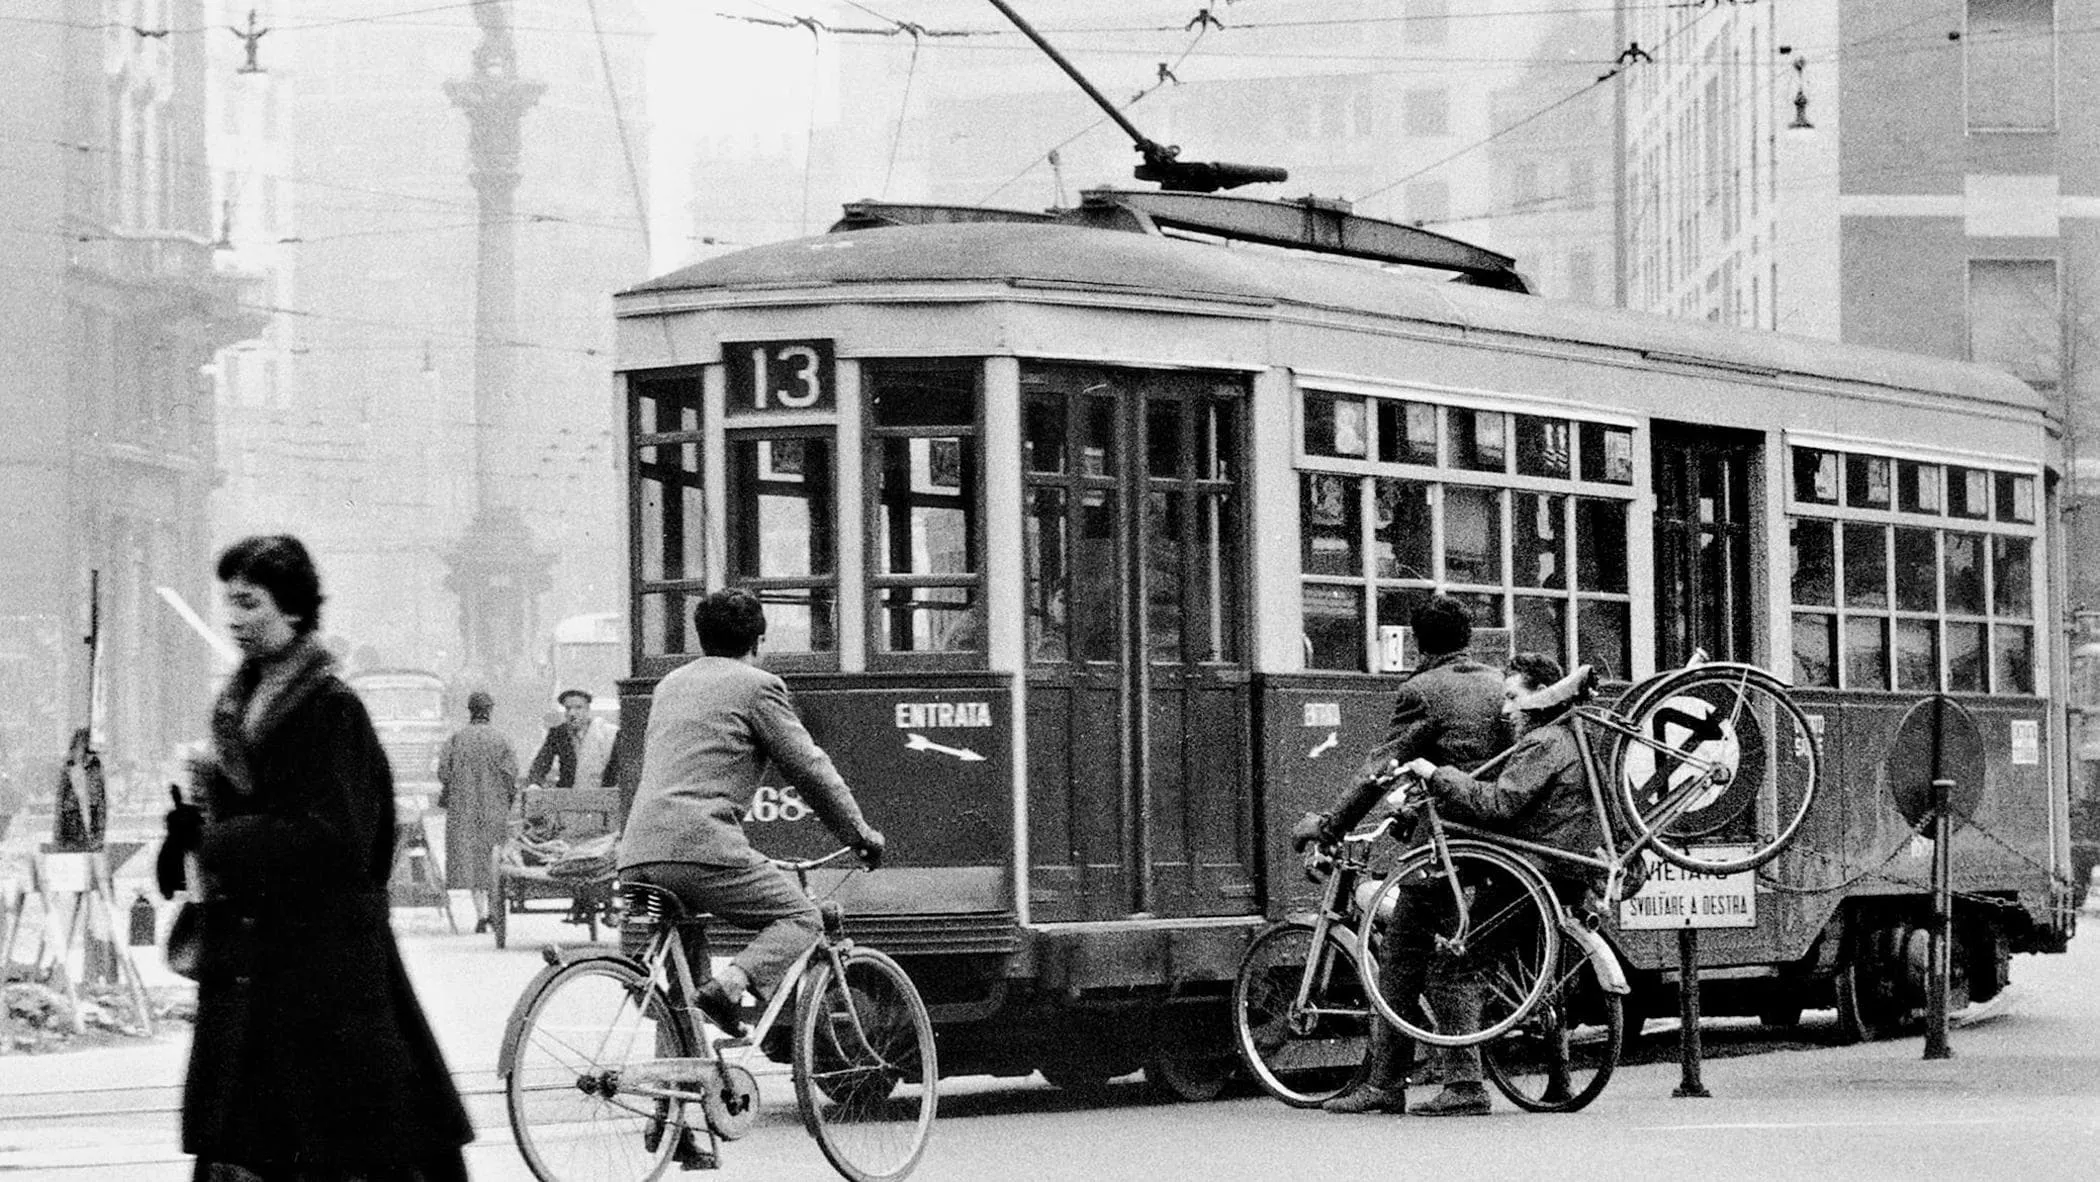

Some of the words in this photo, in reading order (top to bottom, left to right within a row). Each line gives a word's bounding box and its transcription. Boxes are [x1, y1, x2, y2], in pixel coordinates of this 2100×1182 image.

[751, 346, 820, 408] 13
[895, 702, 992, 728] ENTRATA
[743, 786, 820, 822] 68
[1630, 896, 1685, 916] SVOLTARE
[1691, 895, 1698, 914] A
[1703, 894, 1748, 915] DESTRA
